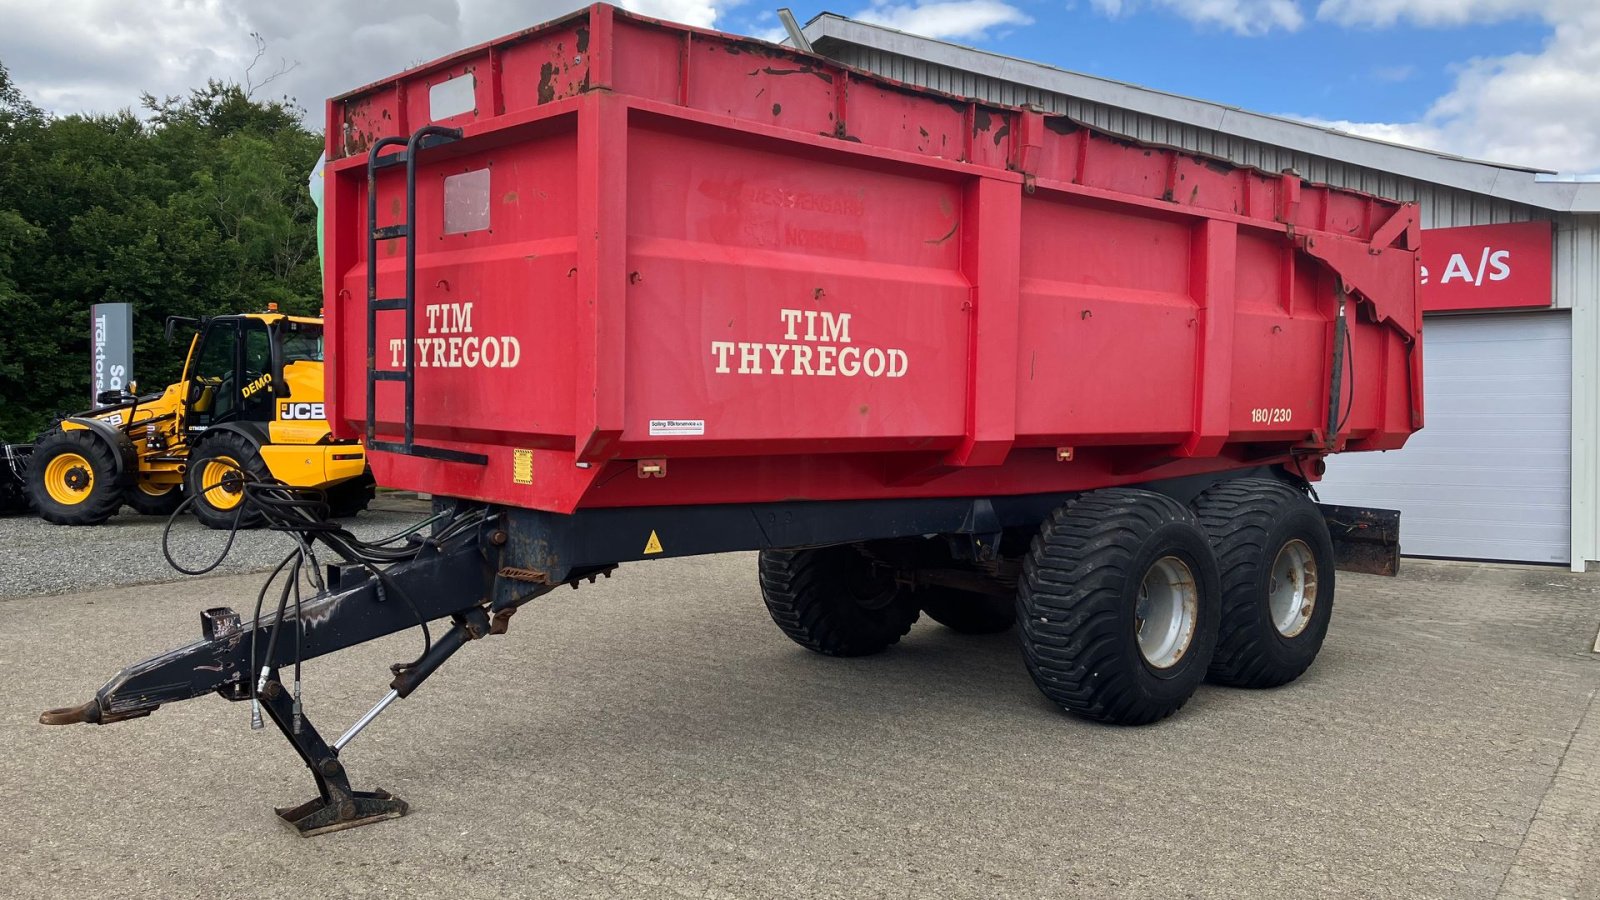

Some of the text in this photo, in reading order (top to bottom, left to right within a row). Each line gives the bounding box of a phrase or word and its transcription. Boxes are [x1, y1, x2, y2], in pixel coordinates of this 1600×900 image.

[1440, 247, 1511, 287] A/S
[426, 302, 473, 334] TIM
[780, 309, 852, 343] TIM
[711, 341, 909, 378] THYREGOD
[110, 364, 125, 391] Sa
[241, 373, 273, 398] DEMO
[281, 403, 326, 420] JCB
[1251, 408, 1292, 424] 180/230
